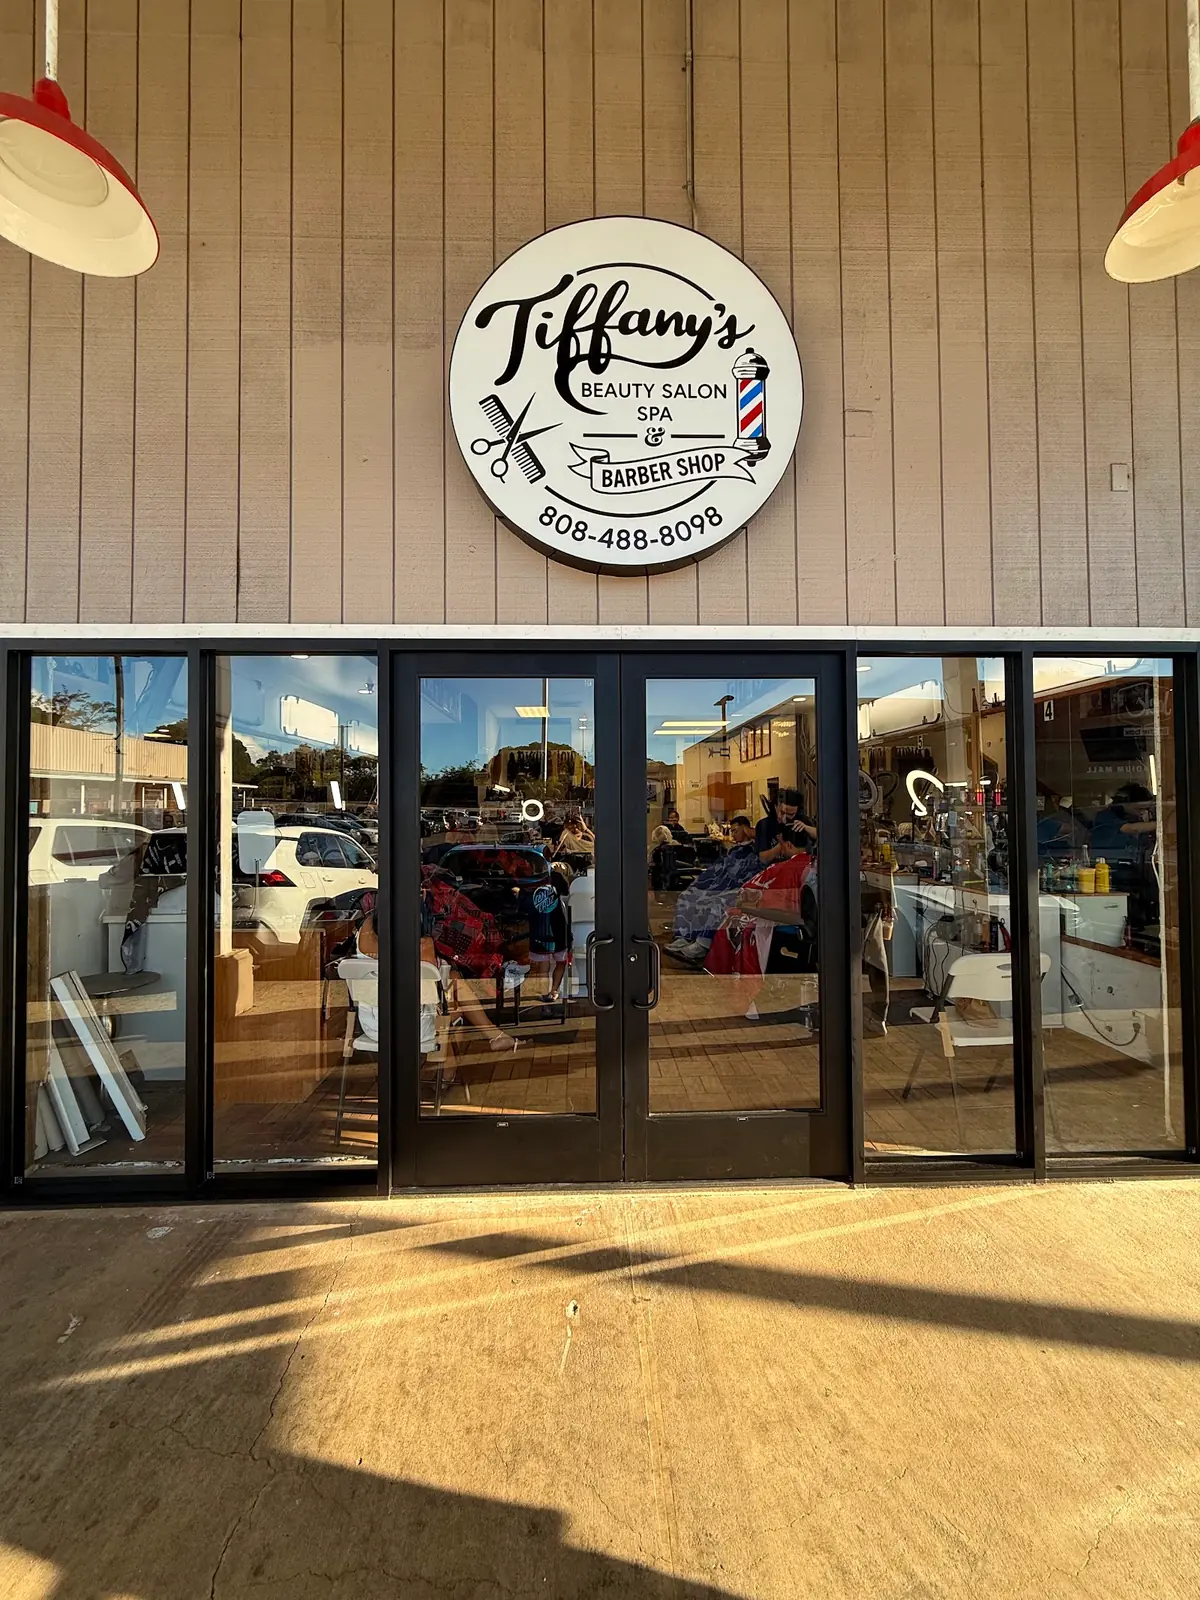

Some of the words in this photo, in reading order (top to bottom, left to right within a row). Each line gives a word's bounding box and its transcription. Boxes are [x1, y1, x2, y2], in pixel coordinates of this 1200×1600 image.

[475, 273, 756, 415] Tiffany's
[581, 383, 655, 398] BEAUTY
[661, 383, 727, 399] SALON
[637, 406, 673, 422] SPA
[644, 426, 666, 447] &
[601, 463, 673, 488] BARBER
[678, 453, 726, 476] SHOP
[538, 506, 723, 550] 808-488-8098
[1045, 701, 1053, 719] 4
